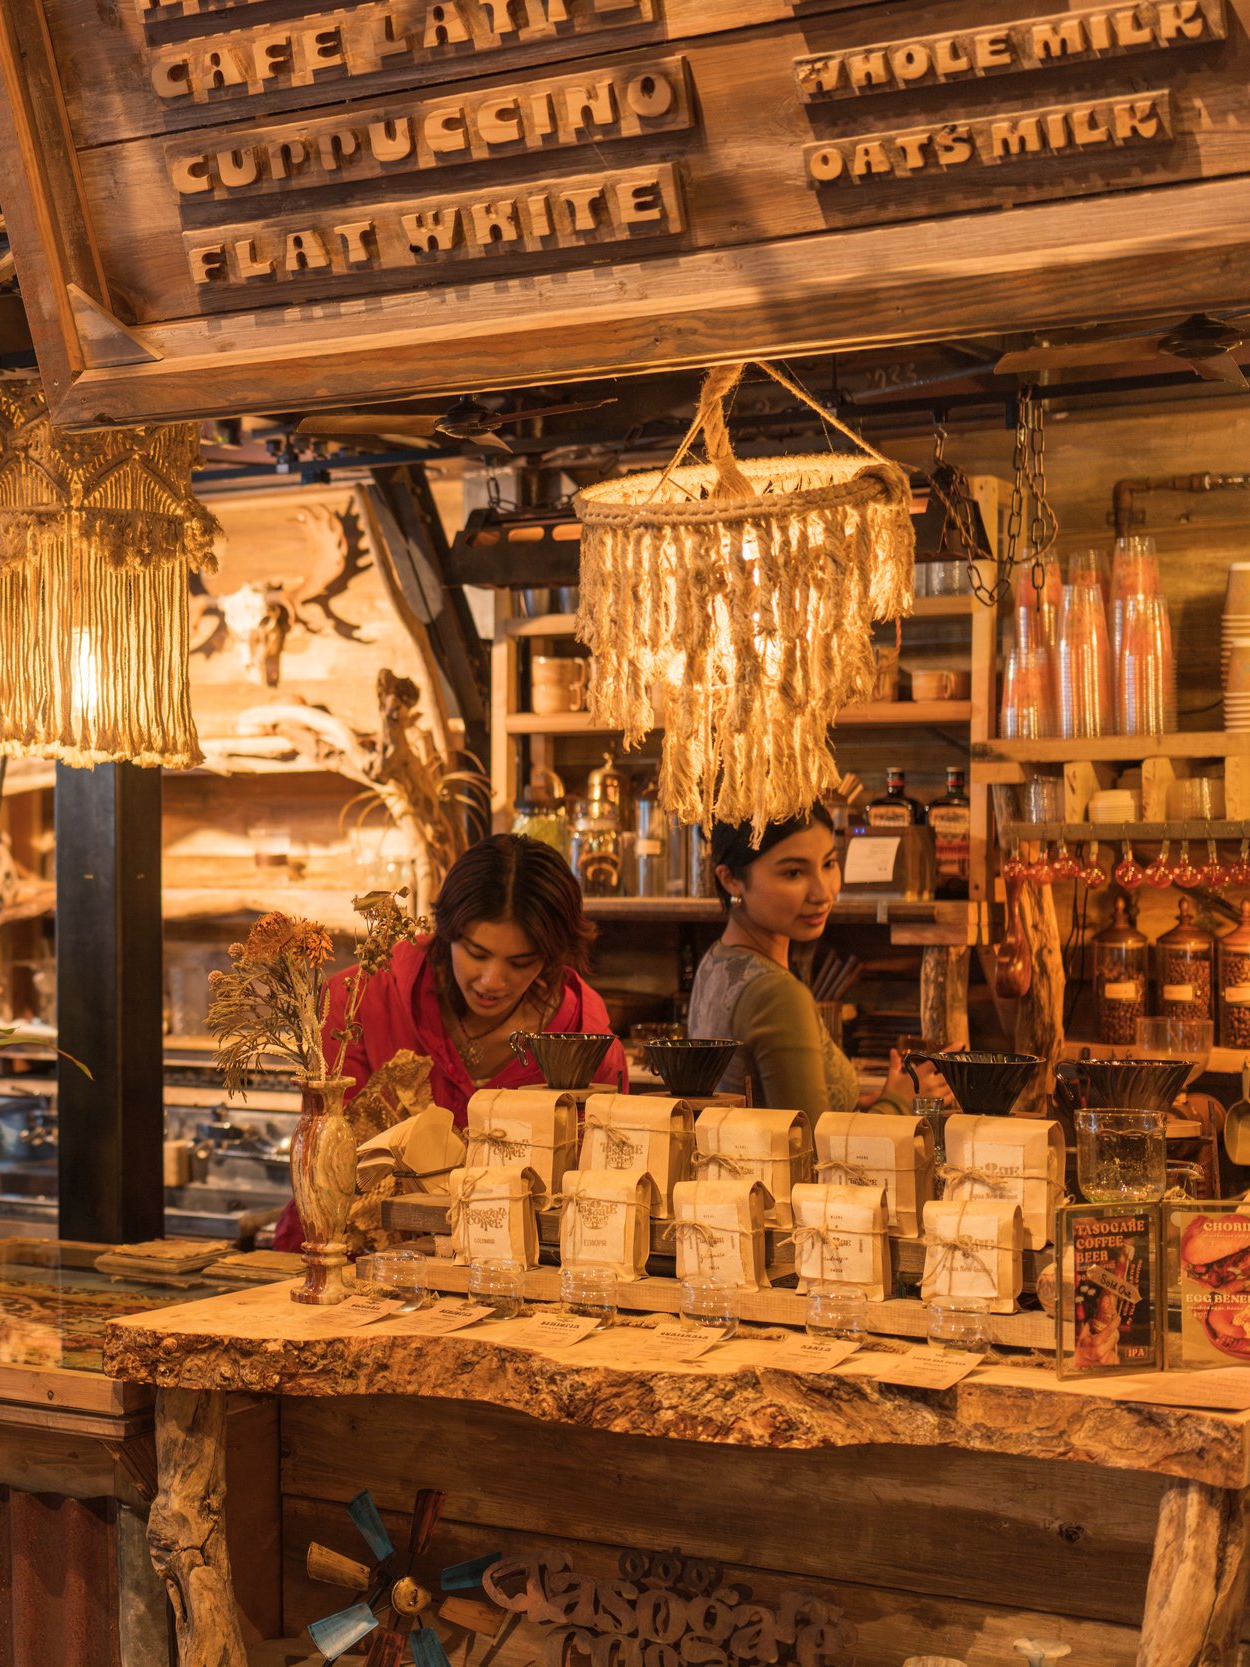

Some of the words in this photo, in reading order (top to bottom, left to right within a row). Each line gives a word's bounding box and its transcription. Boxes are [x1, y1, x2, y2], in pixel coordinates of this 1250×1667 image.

[152, 26, 345, 98] CAFE
[371, 0, 639, 57] LAT
[797, 31, 1011, 94] WHOLE
[1033, 1, 1203, 60] MILK
[172, 72, 672, 194] CUPPUCCINO
[810, 125, 972, 182] OATS
[992, 101, 1157, 156] MILK
[188, 221, 375, 284] FLAT
[401, 182, 662, 252] WHITE
[1075, 1219, 1145, 1236] TASOGARE
[1203, 1222, 1250, 1231] CHORI
[1076, 1235, 1124, 1249] COFFEE
[1077, 1251, 1108, 1264] BEER
[1186, 1294, 1211, 1303] EGG
[1214, 1295, 1250, 1304] BENE
[1128, 1349, 1145, 1358] IPA
